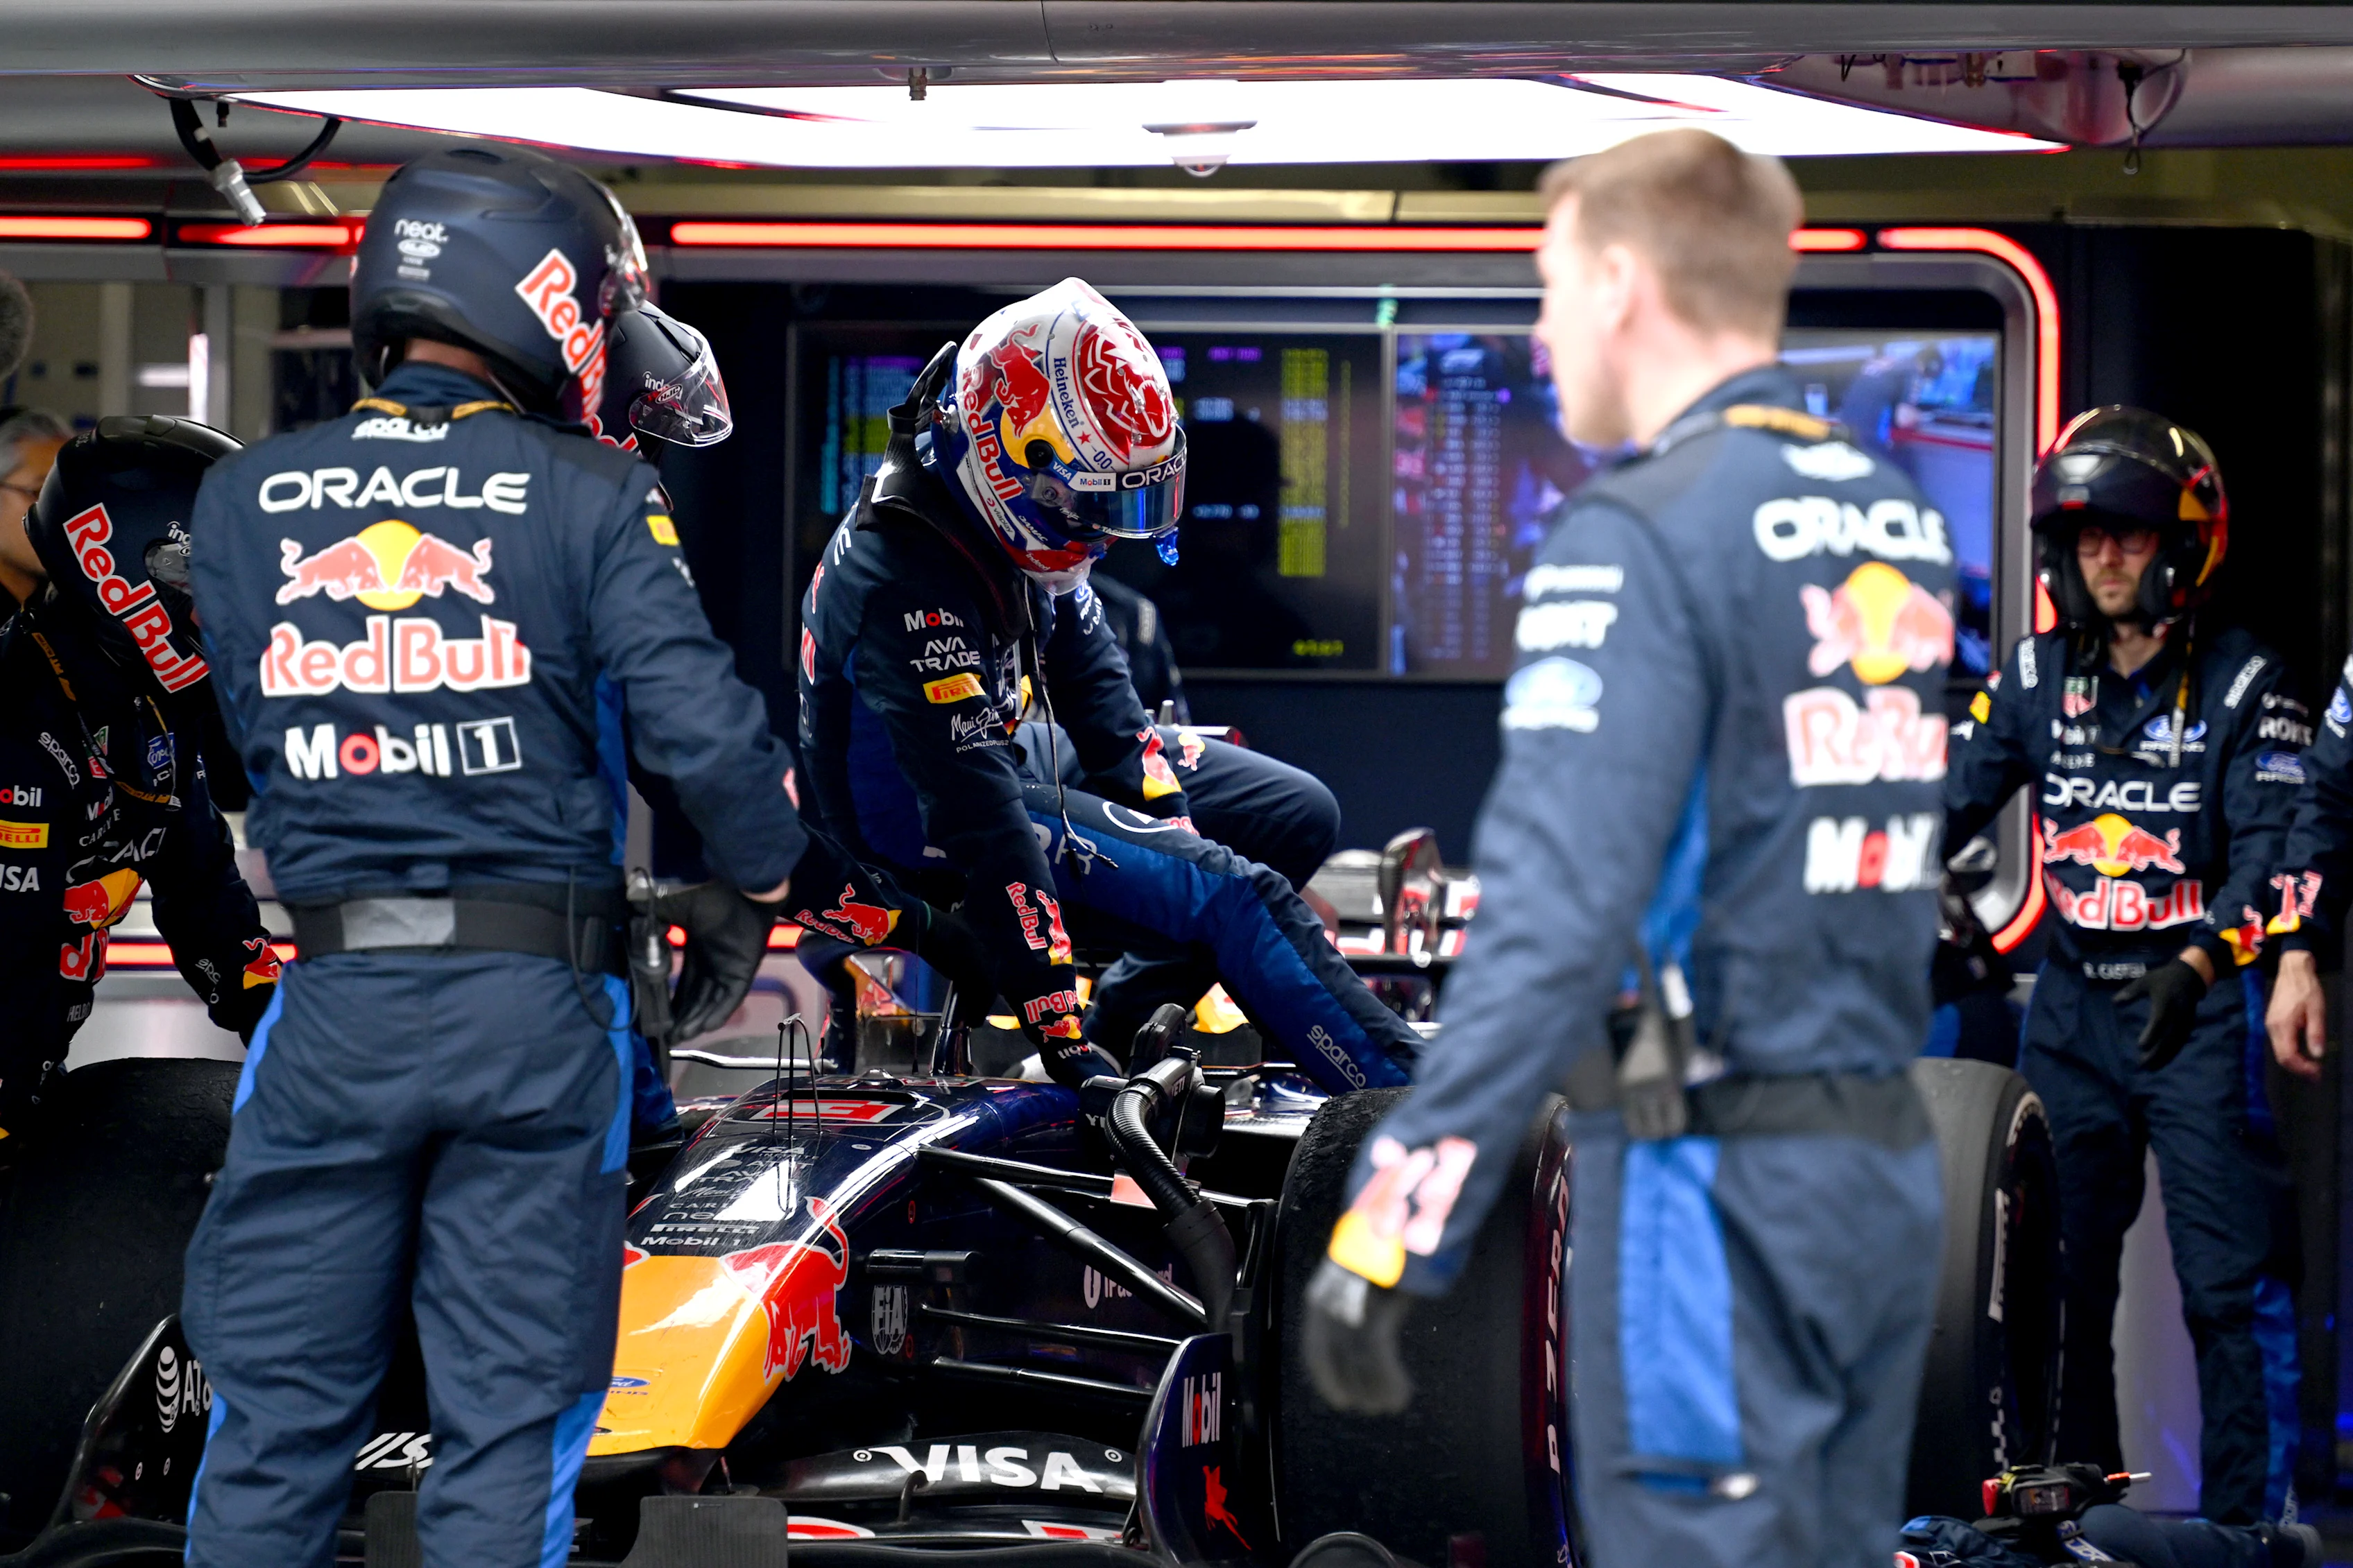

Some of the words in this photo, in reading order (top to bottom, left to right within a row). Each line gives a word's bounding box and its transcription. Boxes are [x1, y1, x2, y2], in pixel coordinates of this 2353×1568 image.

[1054, 357, 1080, 429] Heineken
[258, 466, 532, 514] ORACLE
[1052, 461, 1072, 481] VISA
[1080, 477, 1102, 486] Mobil
[909, 651, 980, 673] TRADE
[925, 637, 966, 657] AVA
[38, 732, 80, 790] sparco
[285, 724, 451, 779] Mobil
[0, 785, 42, 807] obil
[0, 863, 40, 893] ISA
[1307, 1025, 1366, 1089] sparco
[640, 1236, 719, 1246] Mobil
[1182, 1371, 1221, 1448] Mobil
[869, 1445, 1104, 1493] VISA
